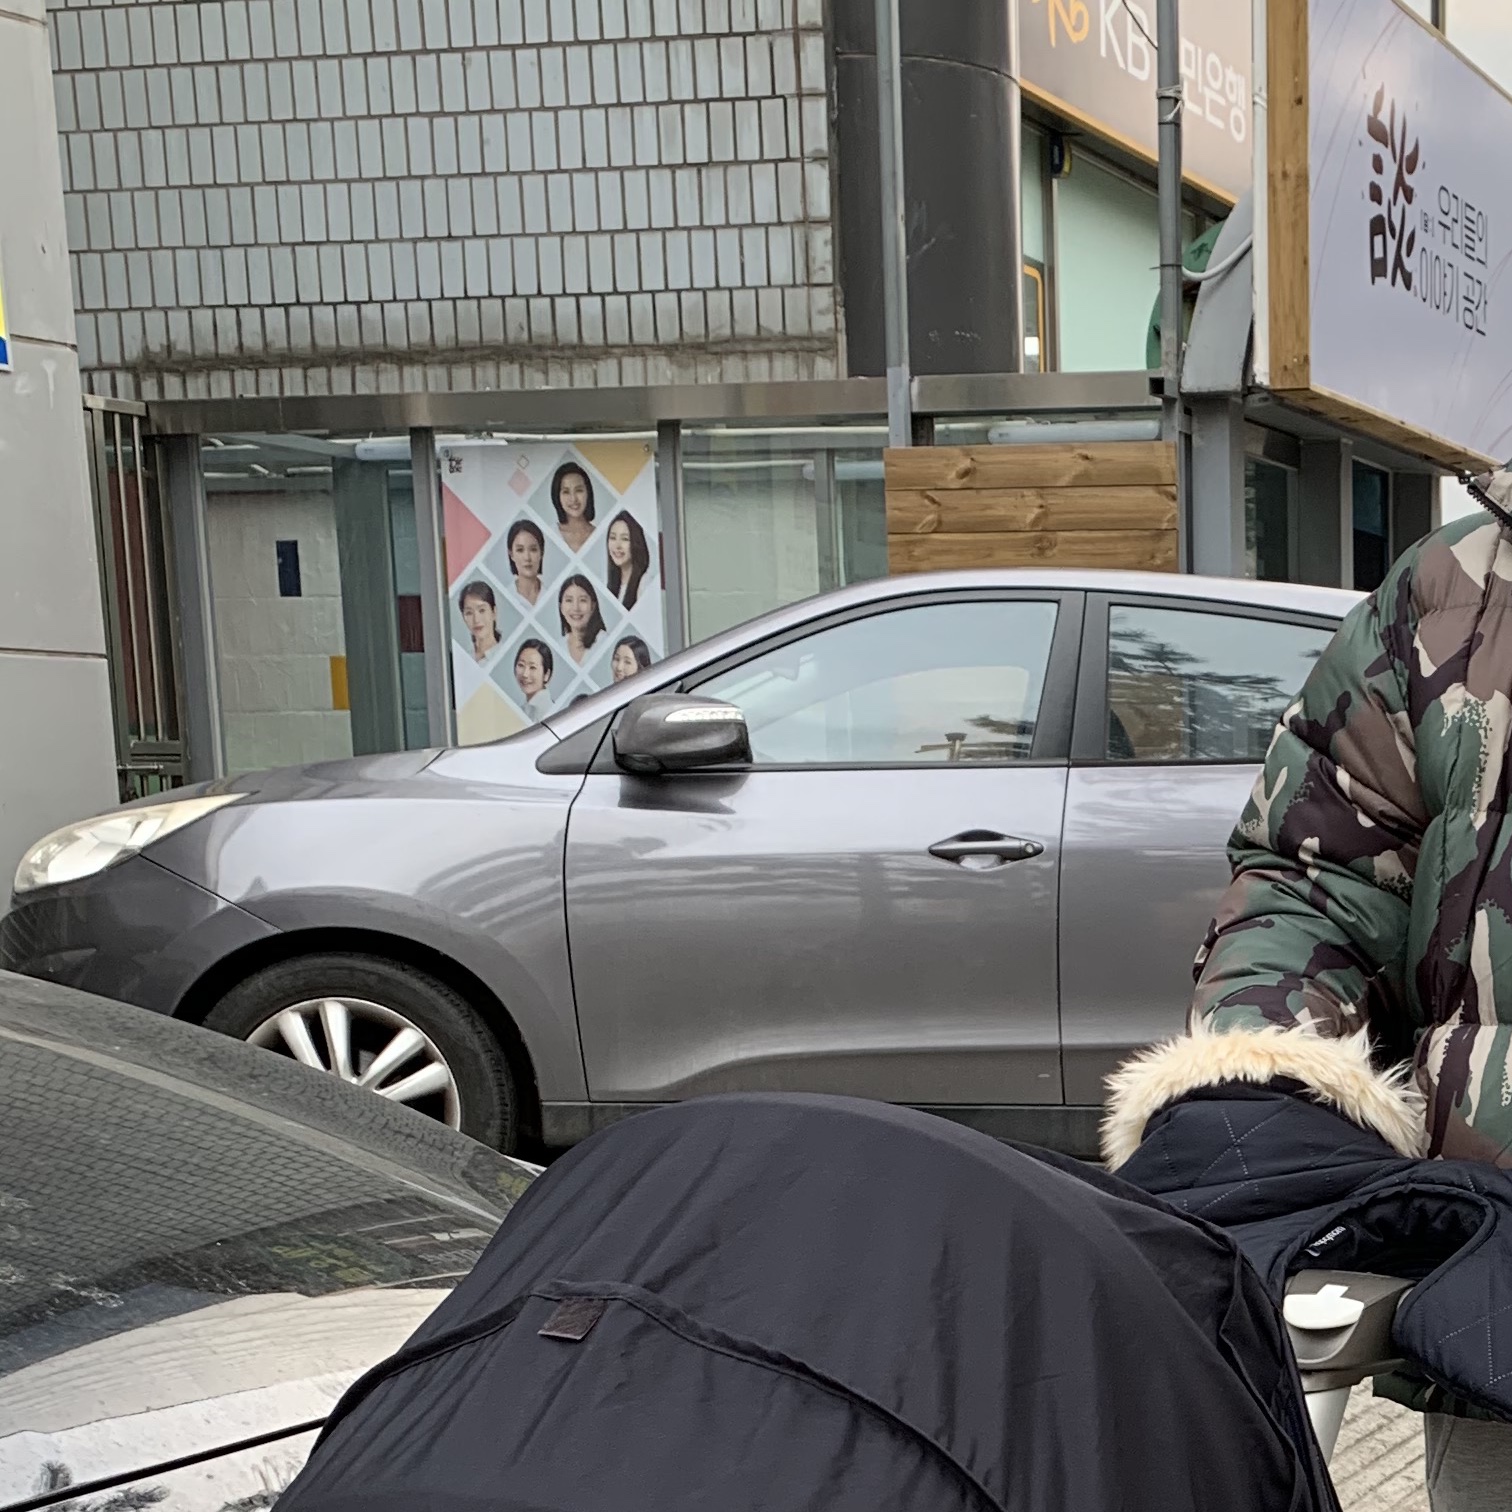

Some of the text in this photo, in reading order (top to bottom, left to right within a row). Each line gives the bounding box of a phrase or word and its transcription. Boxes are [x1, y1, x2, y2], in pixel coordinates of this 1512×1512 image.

[1437, 185, 1488, 269] 우리들의
[1419, 246, 1488, 337] 이야기 공간
